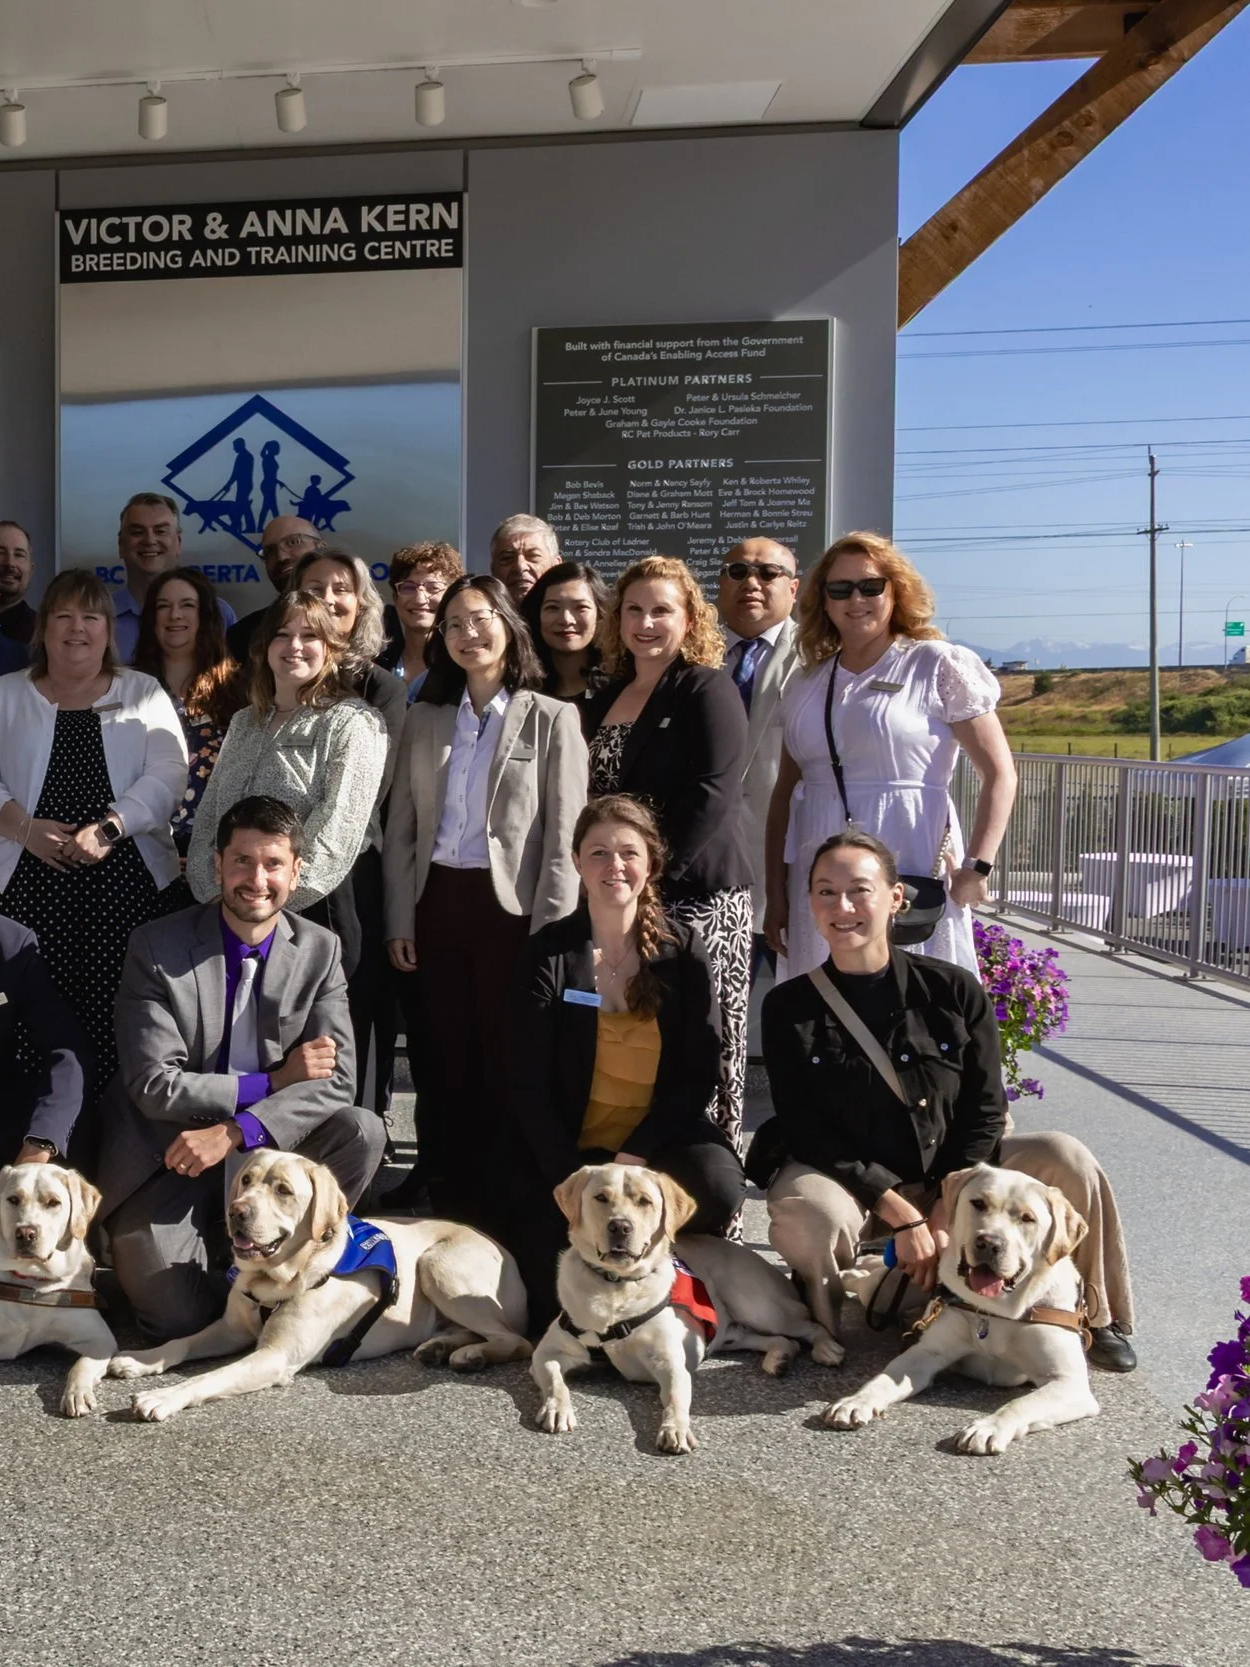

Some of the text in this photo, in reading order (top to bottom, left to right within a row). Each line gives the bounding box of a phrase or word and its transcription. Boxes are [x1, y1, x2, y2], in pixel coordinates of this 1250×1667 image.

[65, 202, 458, 245] VICTOR & ANNA KERN
[71, 240, 453, 272] BREEDING AND TRAINING CENTRE
[565, 335, 803, 351] Built with financial support from the Government
[601, 348, 765, 361] of Canada's Enabling Access Fund
[612, 374, 752, 387] PLATINUM PARTNERS
[576, 396, 601, 406] Joyce
[613, 395, 635, 403] Scott
[598, 408, 618, 416] June
[621, 408, 647, 417] Young
[674, 406, 686, 414] Dr.
[764, 403, 813, 412] Foundation
[606, 420, 639, 428] Graham
[651, 419, 675, 428] Gayle
[709, 417, 758, 425] Foundation
[653, 429, 691, 437] Products
[699, 429, 719, 438] Rory
[721, 428, 740, 436] Carr
[628, 458, 733, 469] GOLD PARTNERS
[663, 480, 687, 488] Nancy
[627, 502, 645, 510] Tony
[96, 566, 125, 584] BC
[191, 564, 260, 583] ERTA
